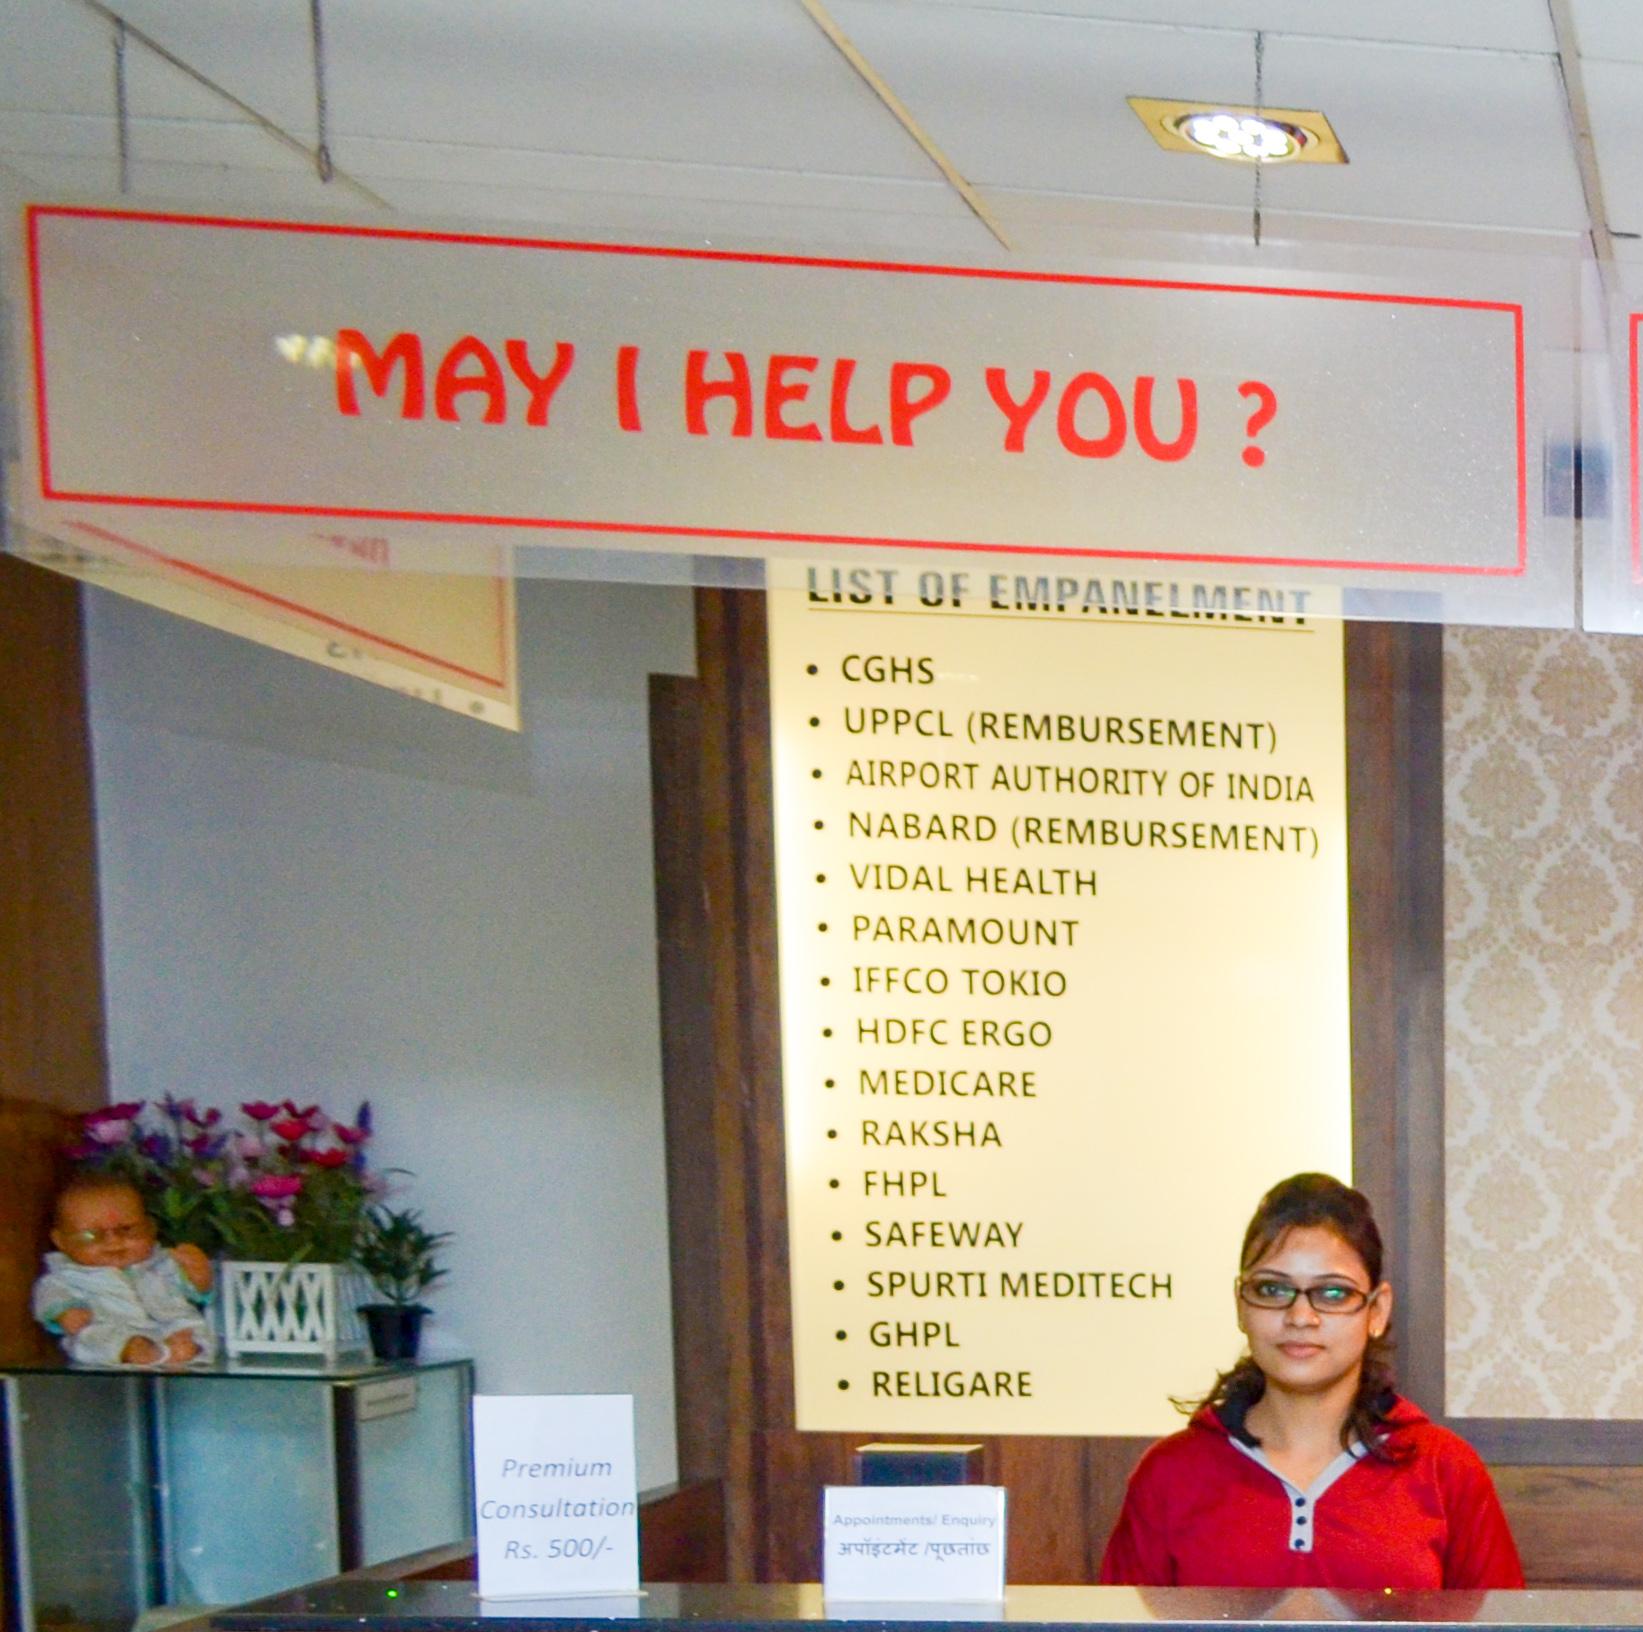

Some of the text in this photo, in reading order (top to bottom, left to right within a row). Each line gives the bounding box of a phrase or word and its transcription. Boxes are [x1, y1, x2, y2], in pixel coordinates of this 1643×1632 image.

[335, 328, 1278, 469] MAY I HELP YOU ?
[807, 566, 1312, 625] LIST OF EMPANELMENT
[842, 655, 934, 684] CGHS
[845, 707, 1276, 753] UPPCL (REMBURSEMENT)
[847, 760, 1313, 801] AIRPORT AUTHORITY OF INDIA
[850, 812, 1318, 855] NABARD (REMBURSEMENT)
[850, 865, 1096, 896] VIDAL HEALTH
[854, 916, 1079, 946] PARAMOUNT
[855, 967, 1066, 996] IFFCO TOKIO
[858, 1019, 1051, 1047] HDFC ERGO
[861, 1070, 1035, 1097] MEDICARE
[863, 1121, 1002, 1147] RAKSHA
[865, 1171, 946, 1197] FHPL
[866, 1221, 1022, 1247] SAFEWAY
[868, 1271, 1171, 1298] SPURTI MEDITECH
[870, 1321, 959, 1347] GHPL
[873, 1371, 1032, 1397] RELIGARE
[501, 1458, 612, 1478] Premium
[480, 1498, 635, 1519] Consultation
[504, 1536, 613, 1560] Rs. 500/-
